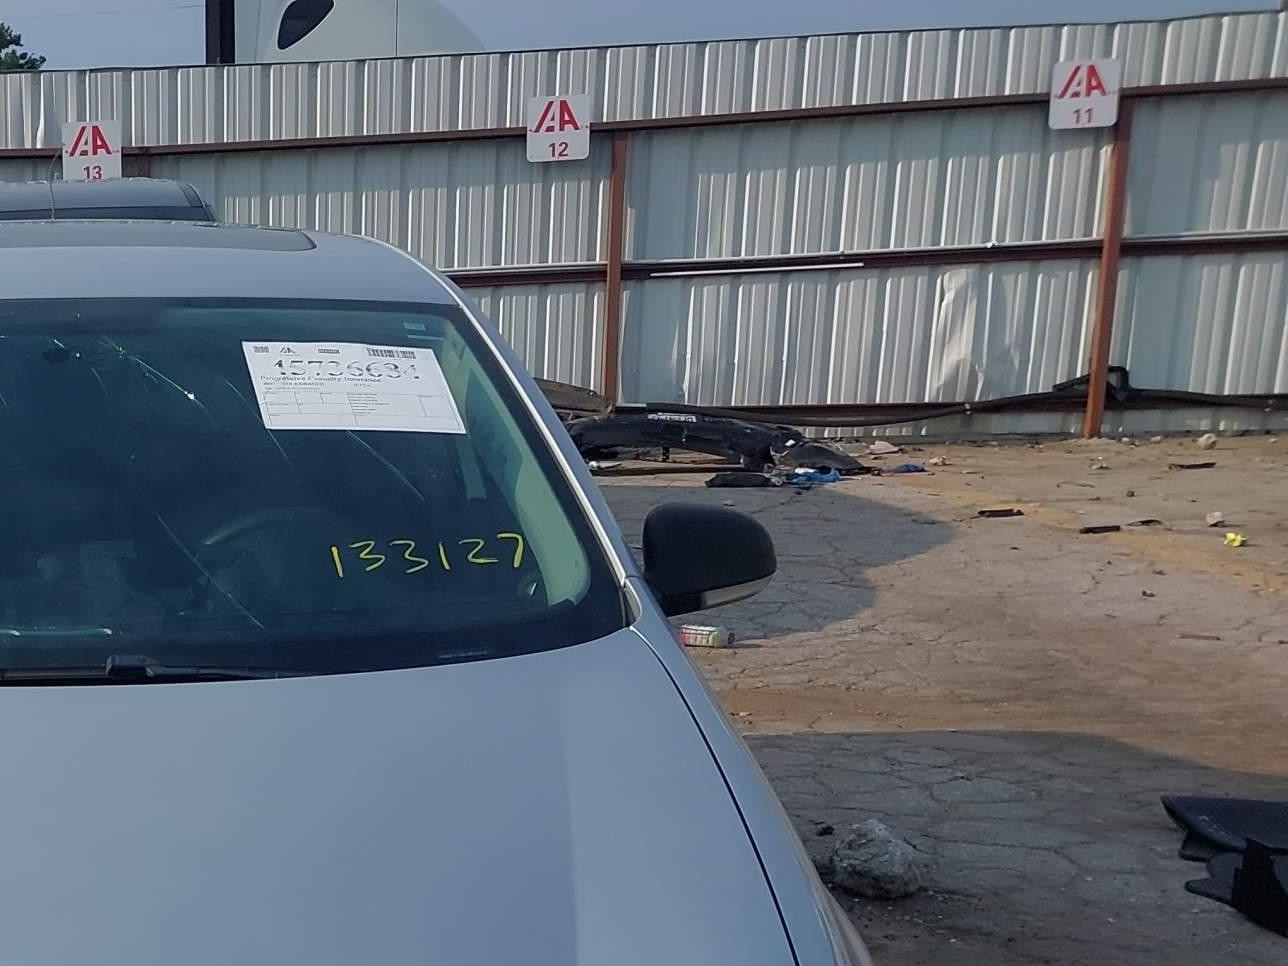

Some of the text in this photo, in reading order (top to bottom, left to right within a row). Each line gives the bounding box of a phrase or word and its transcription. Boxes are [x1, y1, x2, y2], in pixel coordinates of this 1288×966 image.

[1073, 107, 1092, 124] 11
[548, 141, 569, 158] 12
[83, 165, 102, 180] 13
[331, 532, 524, 578] 133127
